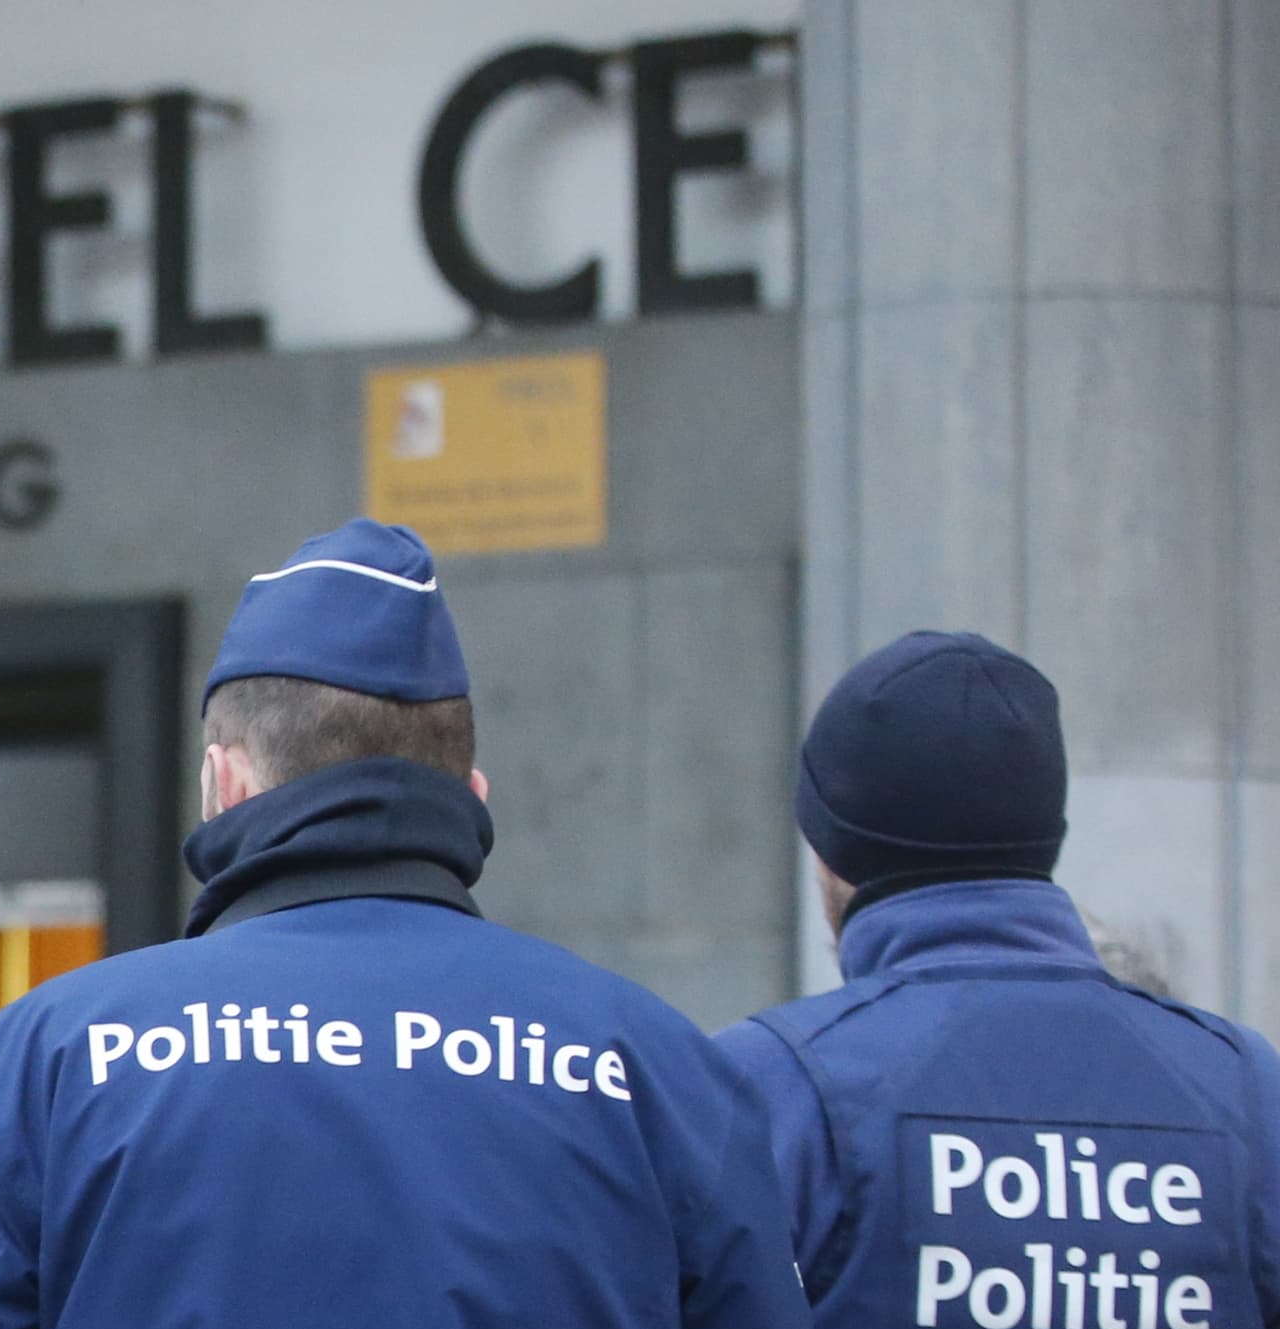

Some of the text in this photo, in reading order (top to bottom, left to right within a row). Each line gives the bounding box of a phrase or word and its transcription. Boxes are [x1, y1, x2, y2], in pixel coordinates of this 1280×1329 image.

[417, 28, 802, 328] CE
[88, 1002, 632, 1101] Politie Police
[930, 1132, 1203, 1225] Police
